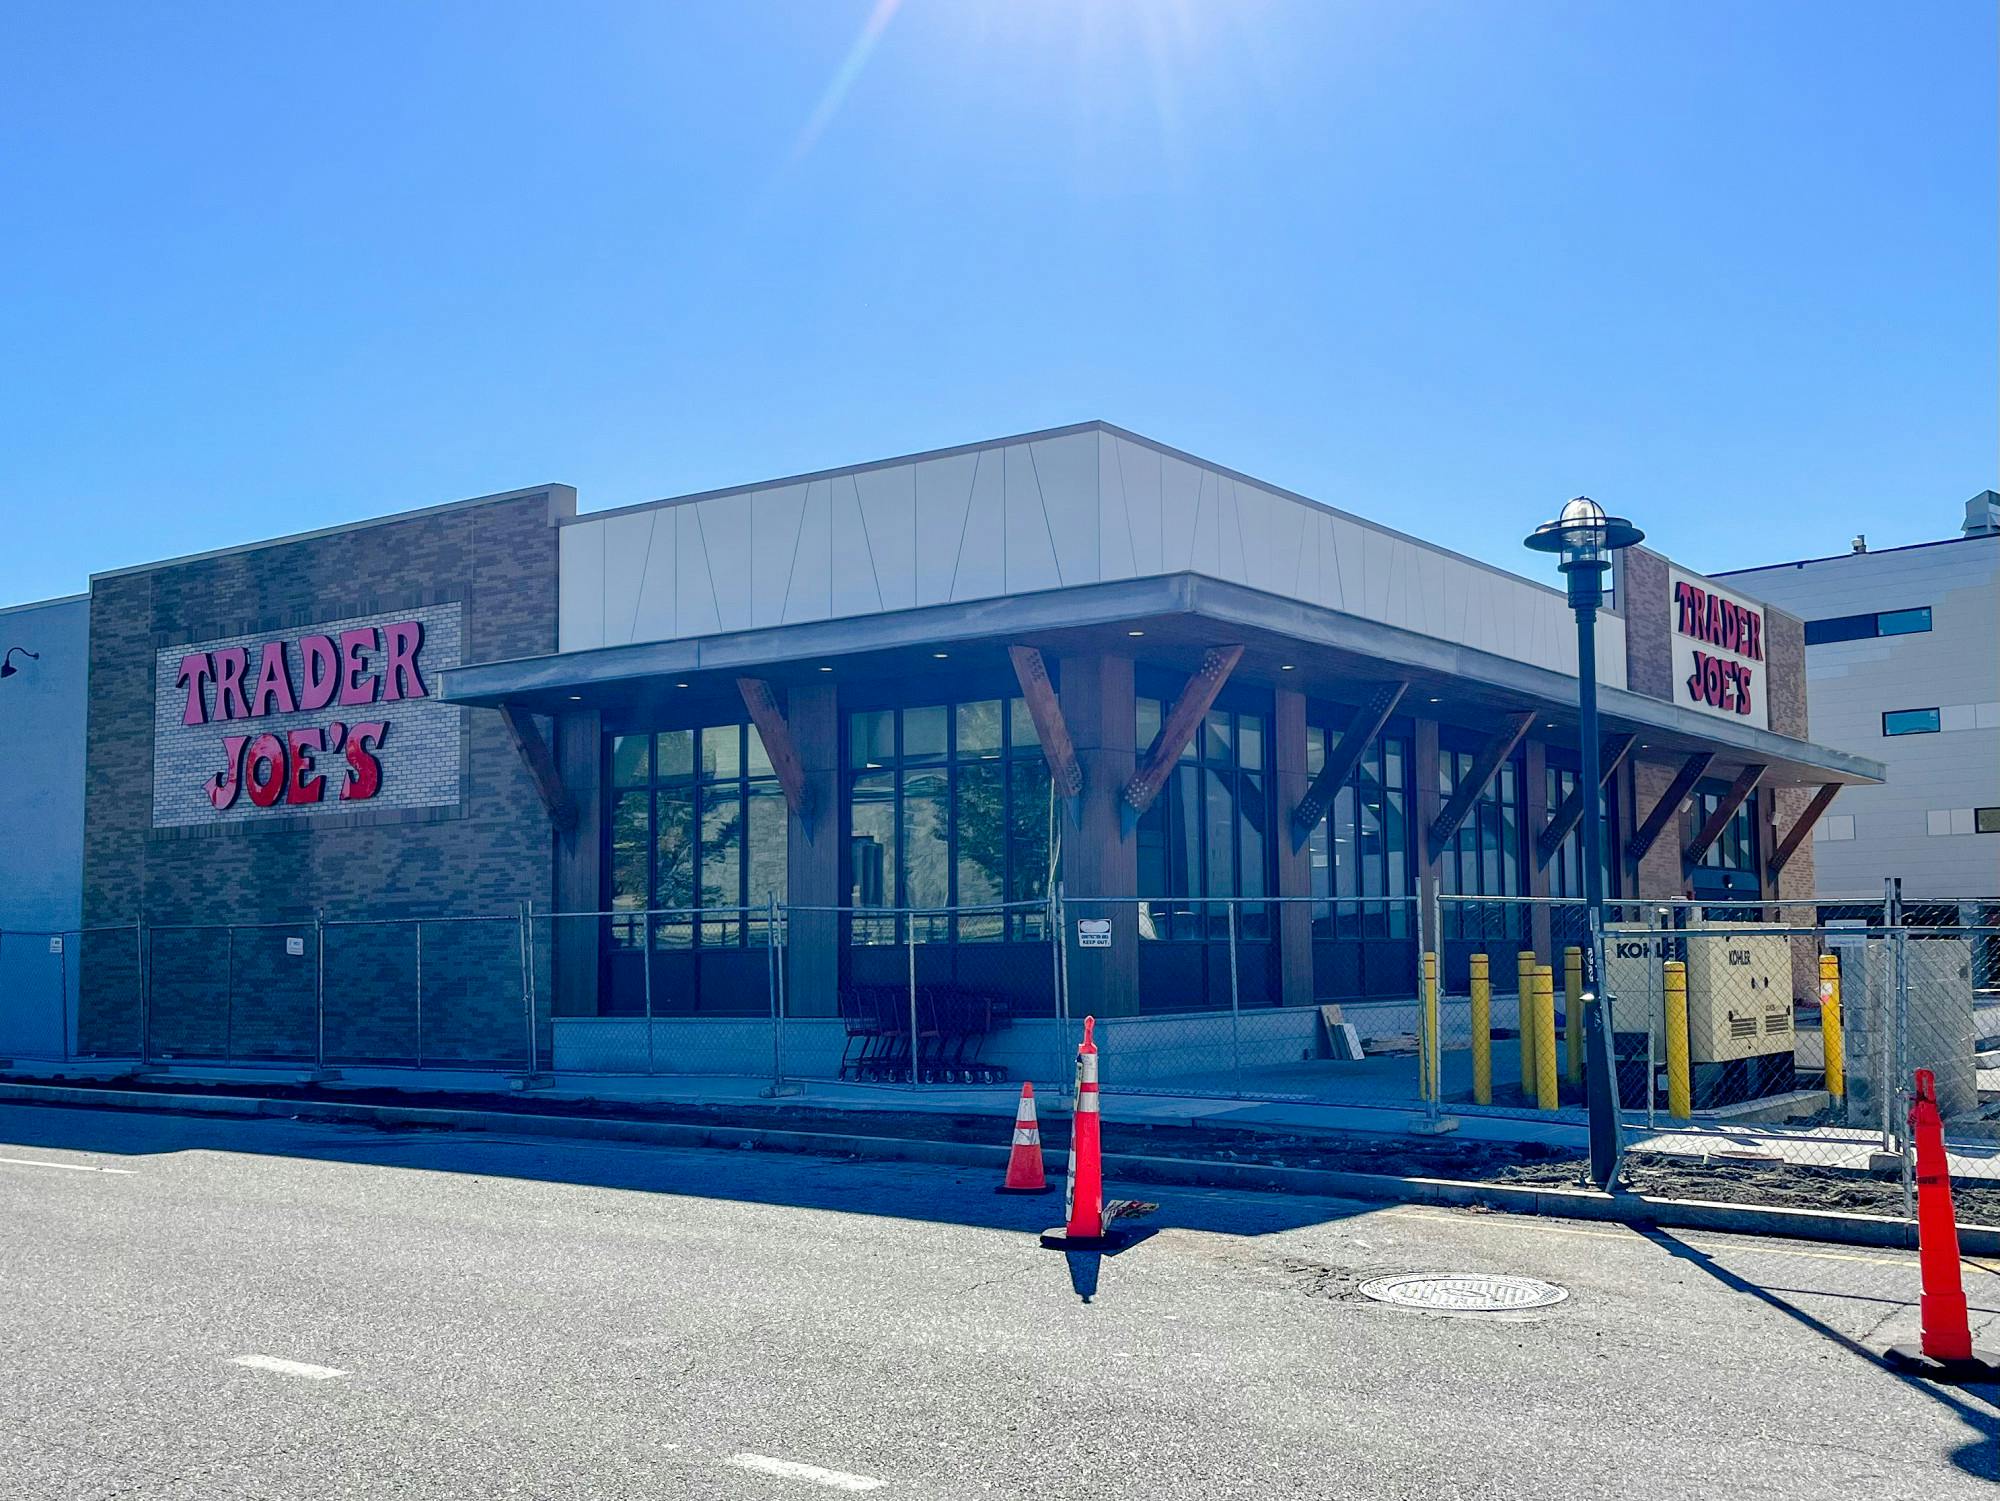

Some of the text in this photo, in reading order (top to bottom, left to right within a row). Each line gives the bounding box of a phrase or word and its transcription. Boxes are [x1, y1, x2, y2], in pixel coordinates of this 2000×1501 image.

[1675, 581, 1763, 661] TRADER
[176, 621, 429, 726] TRADER
[1687, 650, 1752, 715] JOE'S
[202, 720, 390, 811] JOE'S
